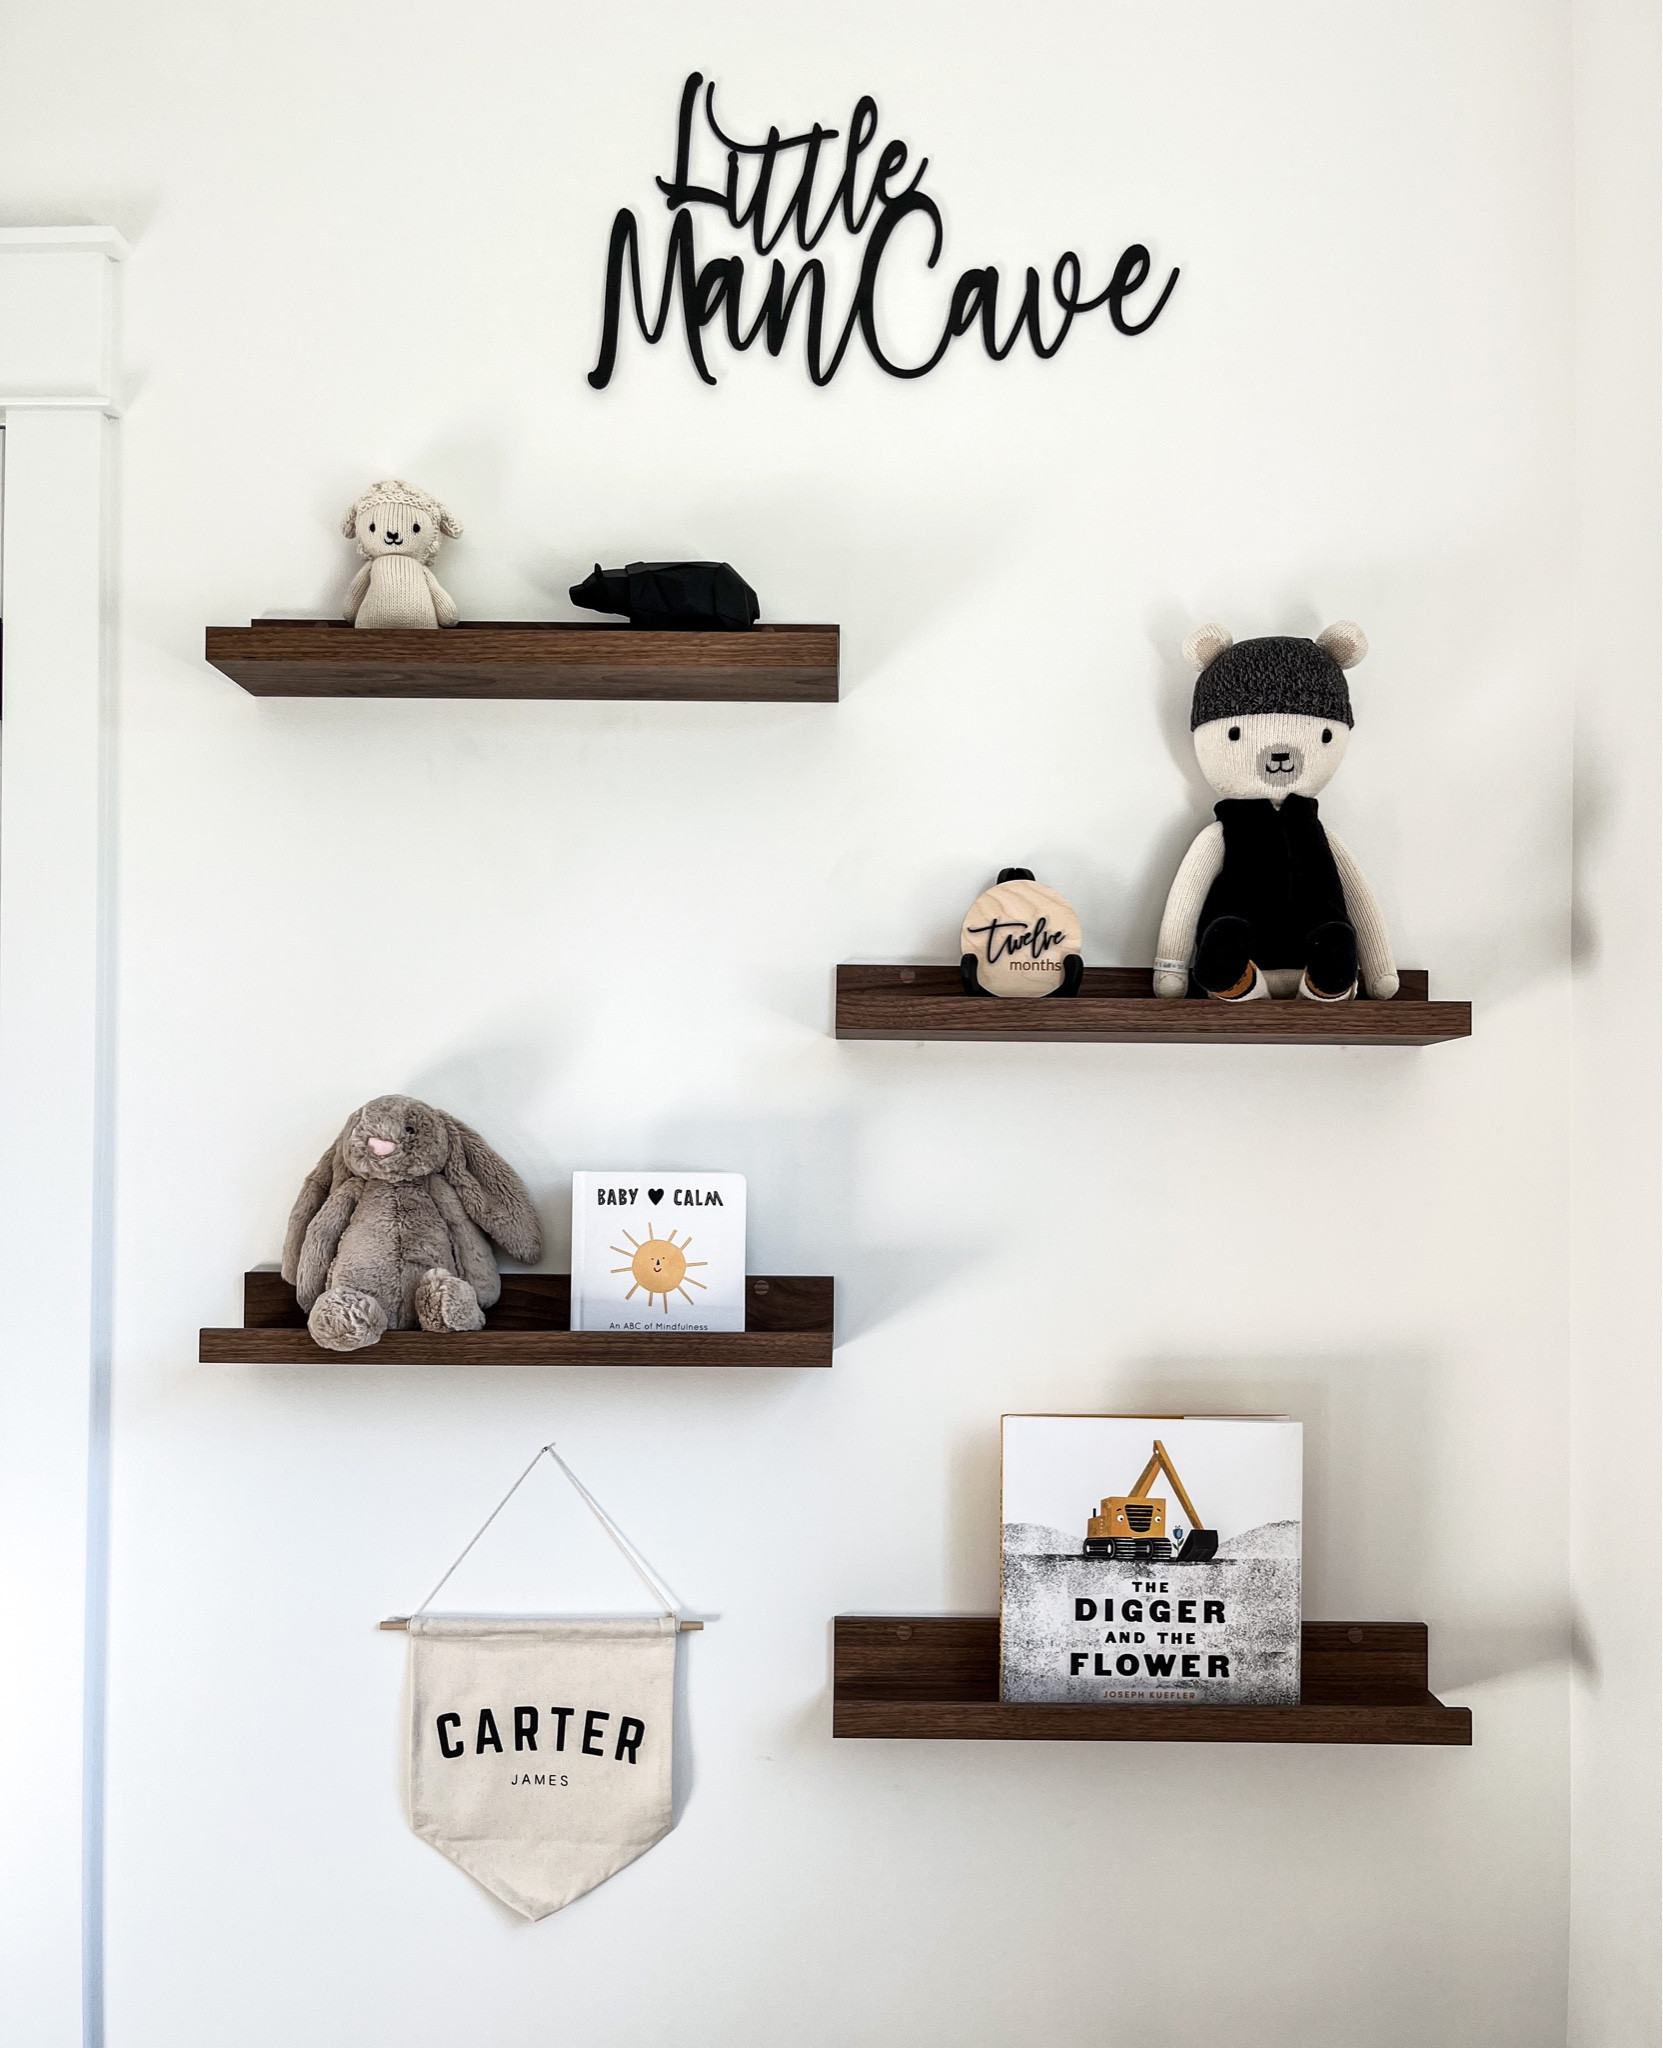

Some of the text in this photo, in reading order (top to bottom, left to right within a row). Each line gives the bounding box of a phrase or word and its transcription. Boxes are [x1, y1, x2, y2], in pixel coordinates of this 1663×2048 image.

[655, 71, 930, 256] Little
[967, 917, 1066, 965] twelve
[1009, 958, 1062, 972] months
[597, 1188, 724, 1207] BABY CALM
[609, 1322, 709, 1331] An ABC of Mindfulness
[1131, 1581, 1169, 1593] THE
[1074, 1597, 1226, 1624] DIGGER
[1104, 1631, 1196, 1645] AND THE
[1070, 1652, 1230, 1678] FLOWER
[1103, 1690, 1196, 1700] JOSEPH KUEFLER
[436, 1705, 645, 1765] CARTER
[511, 1773, 569, 1787] JAMES
